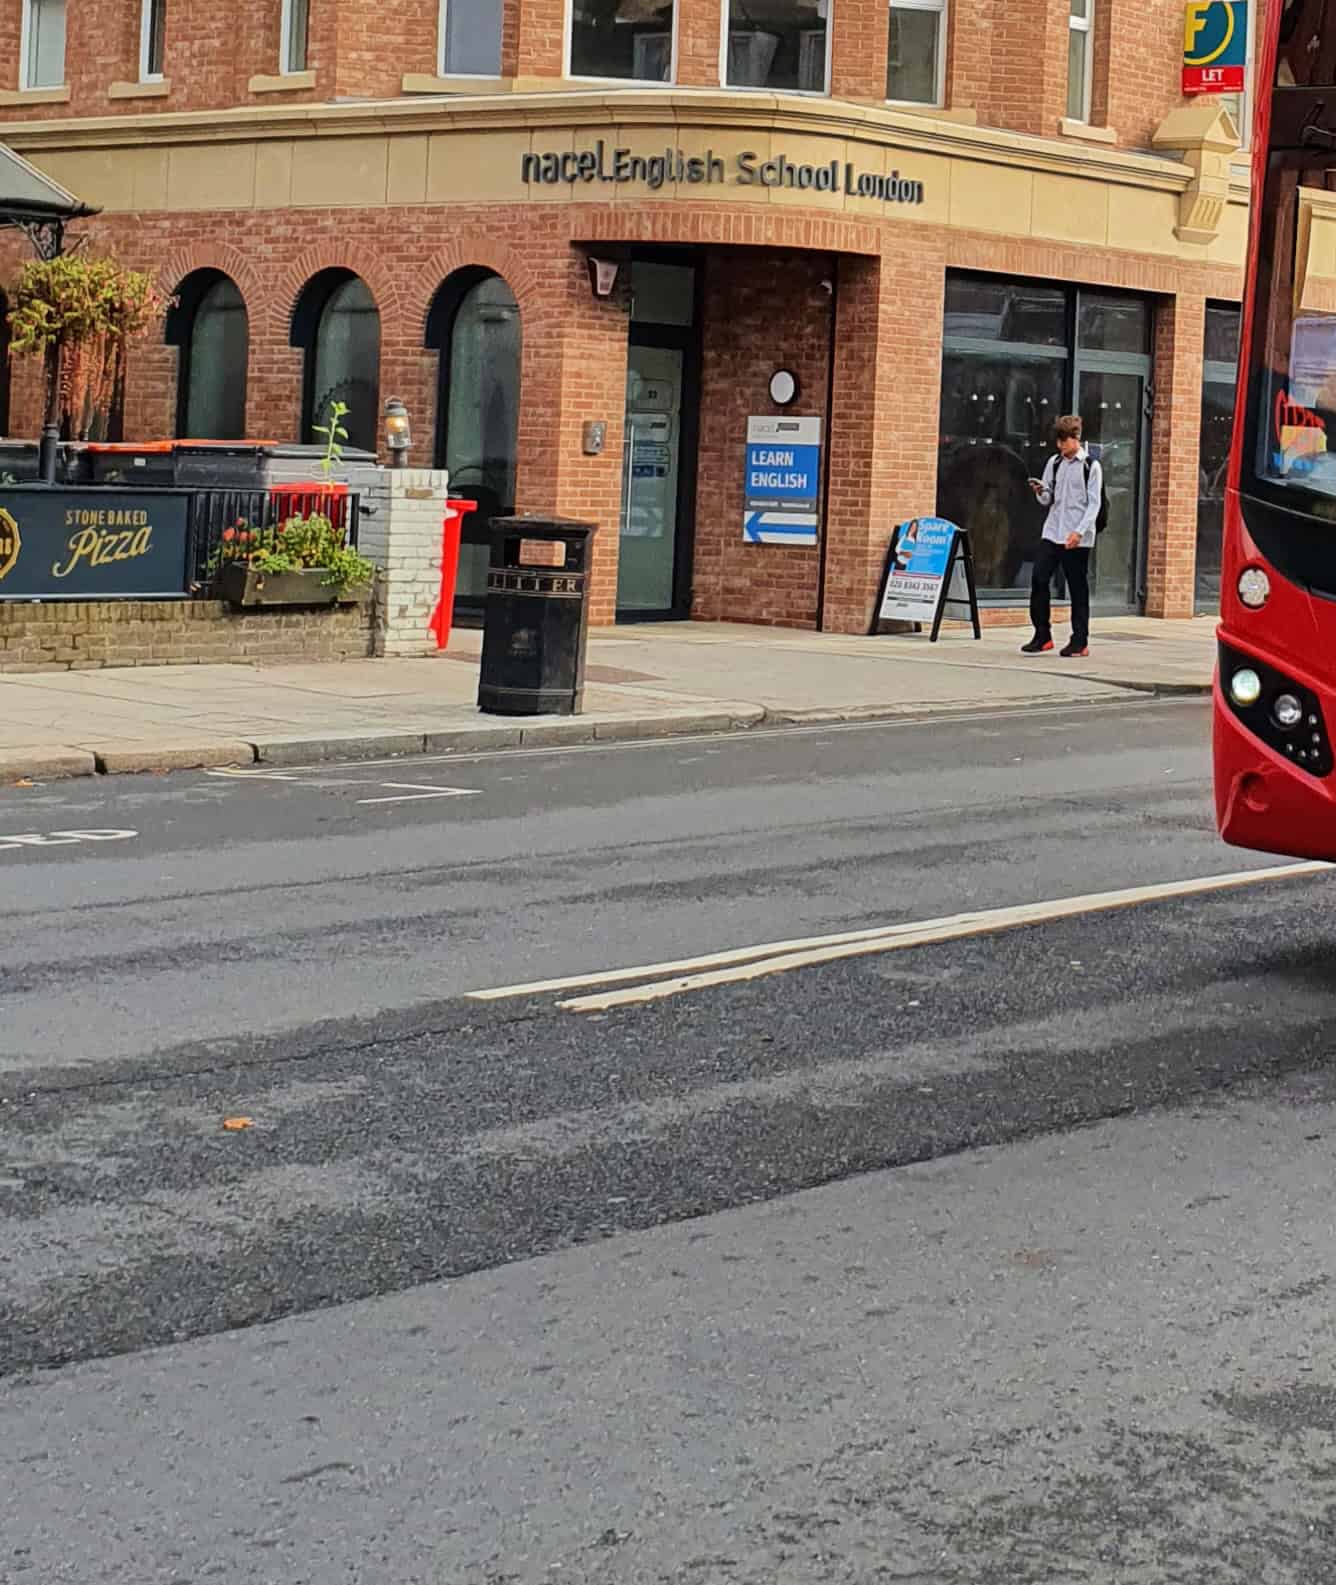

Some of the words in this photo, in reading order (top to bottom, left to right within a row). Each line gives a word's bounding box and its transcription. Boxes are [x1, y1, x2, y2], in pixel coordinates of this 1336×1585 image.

[1202, 69, 1224, 81] LET
[614, 148, 724, 189] English
[736, 151, 839, 192] School
[844, 163, 923, 204] London
[751, 450, 794, 466] LEARN
[751, 472, 807, 488] ENGLISH
[65, 509, 105, 525] STONE
[108, 510, 148, 525] BAKED
[52, 525, 153, 577] Pizza
[493, 576, 577, 592] LITTER
